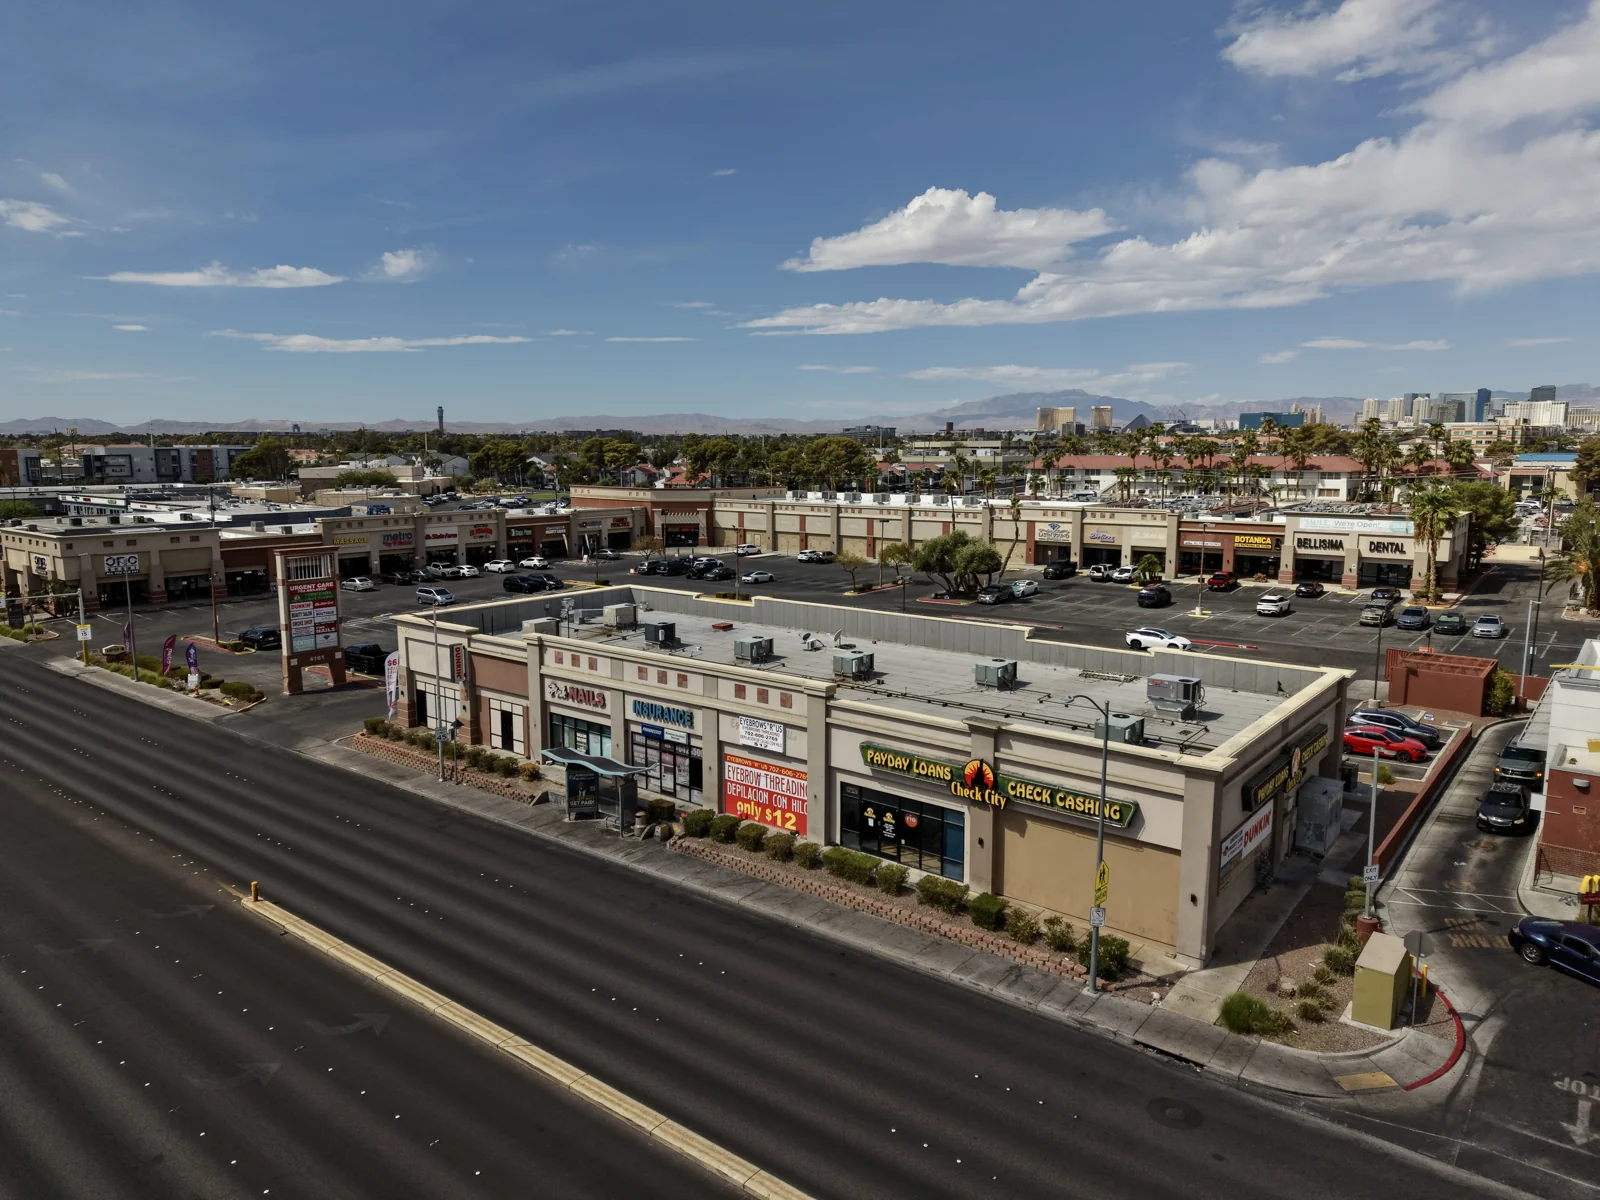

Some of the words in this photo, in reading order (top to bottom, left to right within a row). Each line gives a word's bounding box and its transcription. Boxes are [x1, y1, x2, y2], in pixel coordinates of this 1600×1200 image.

[1356, 521, 1380, 530] Open!
[333, 537, 369, 545] MASSAGE
[383, 531, 413, 541] metro
[1234, 535, 1272, 545] BOTANICA
[1296, 537, 1345, 551] BELLISIMA
[1368, 541, 1407, 555] DENTAL
[289, 583, 316, 592] URGENT
[317, 581, 334, 589] CARE
[387, 658, 398, 667] $6
[568, 686, 607, 708] NAILS
[632, 699, 694, 727] INSURANCE
[740, 717, 767, 730] EYEBROWS
[776, 725, 783, 734] US
[726, 755, 752, 766] EYEBROWS
[867, 748, 910, 771] PAYDAY
[912, 759, 952, 781] LOANS
[727, 764, 762, 787] EYEBROW
[727, 781, 769, 805] DEPILACION
[772, 793, 788, 810] CON
[950, 781, 983, 802] Check
[984, 788, 1007, 810] City
[1007, 781, 1052, 805] CHECK
[736, 801, 762, 821] only
[765, 808, 797, 831] $12
[1364, 874, 1378, 882] ONLY
[1365, 866, 1378, 874] EXIT
